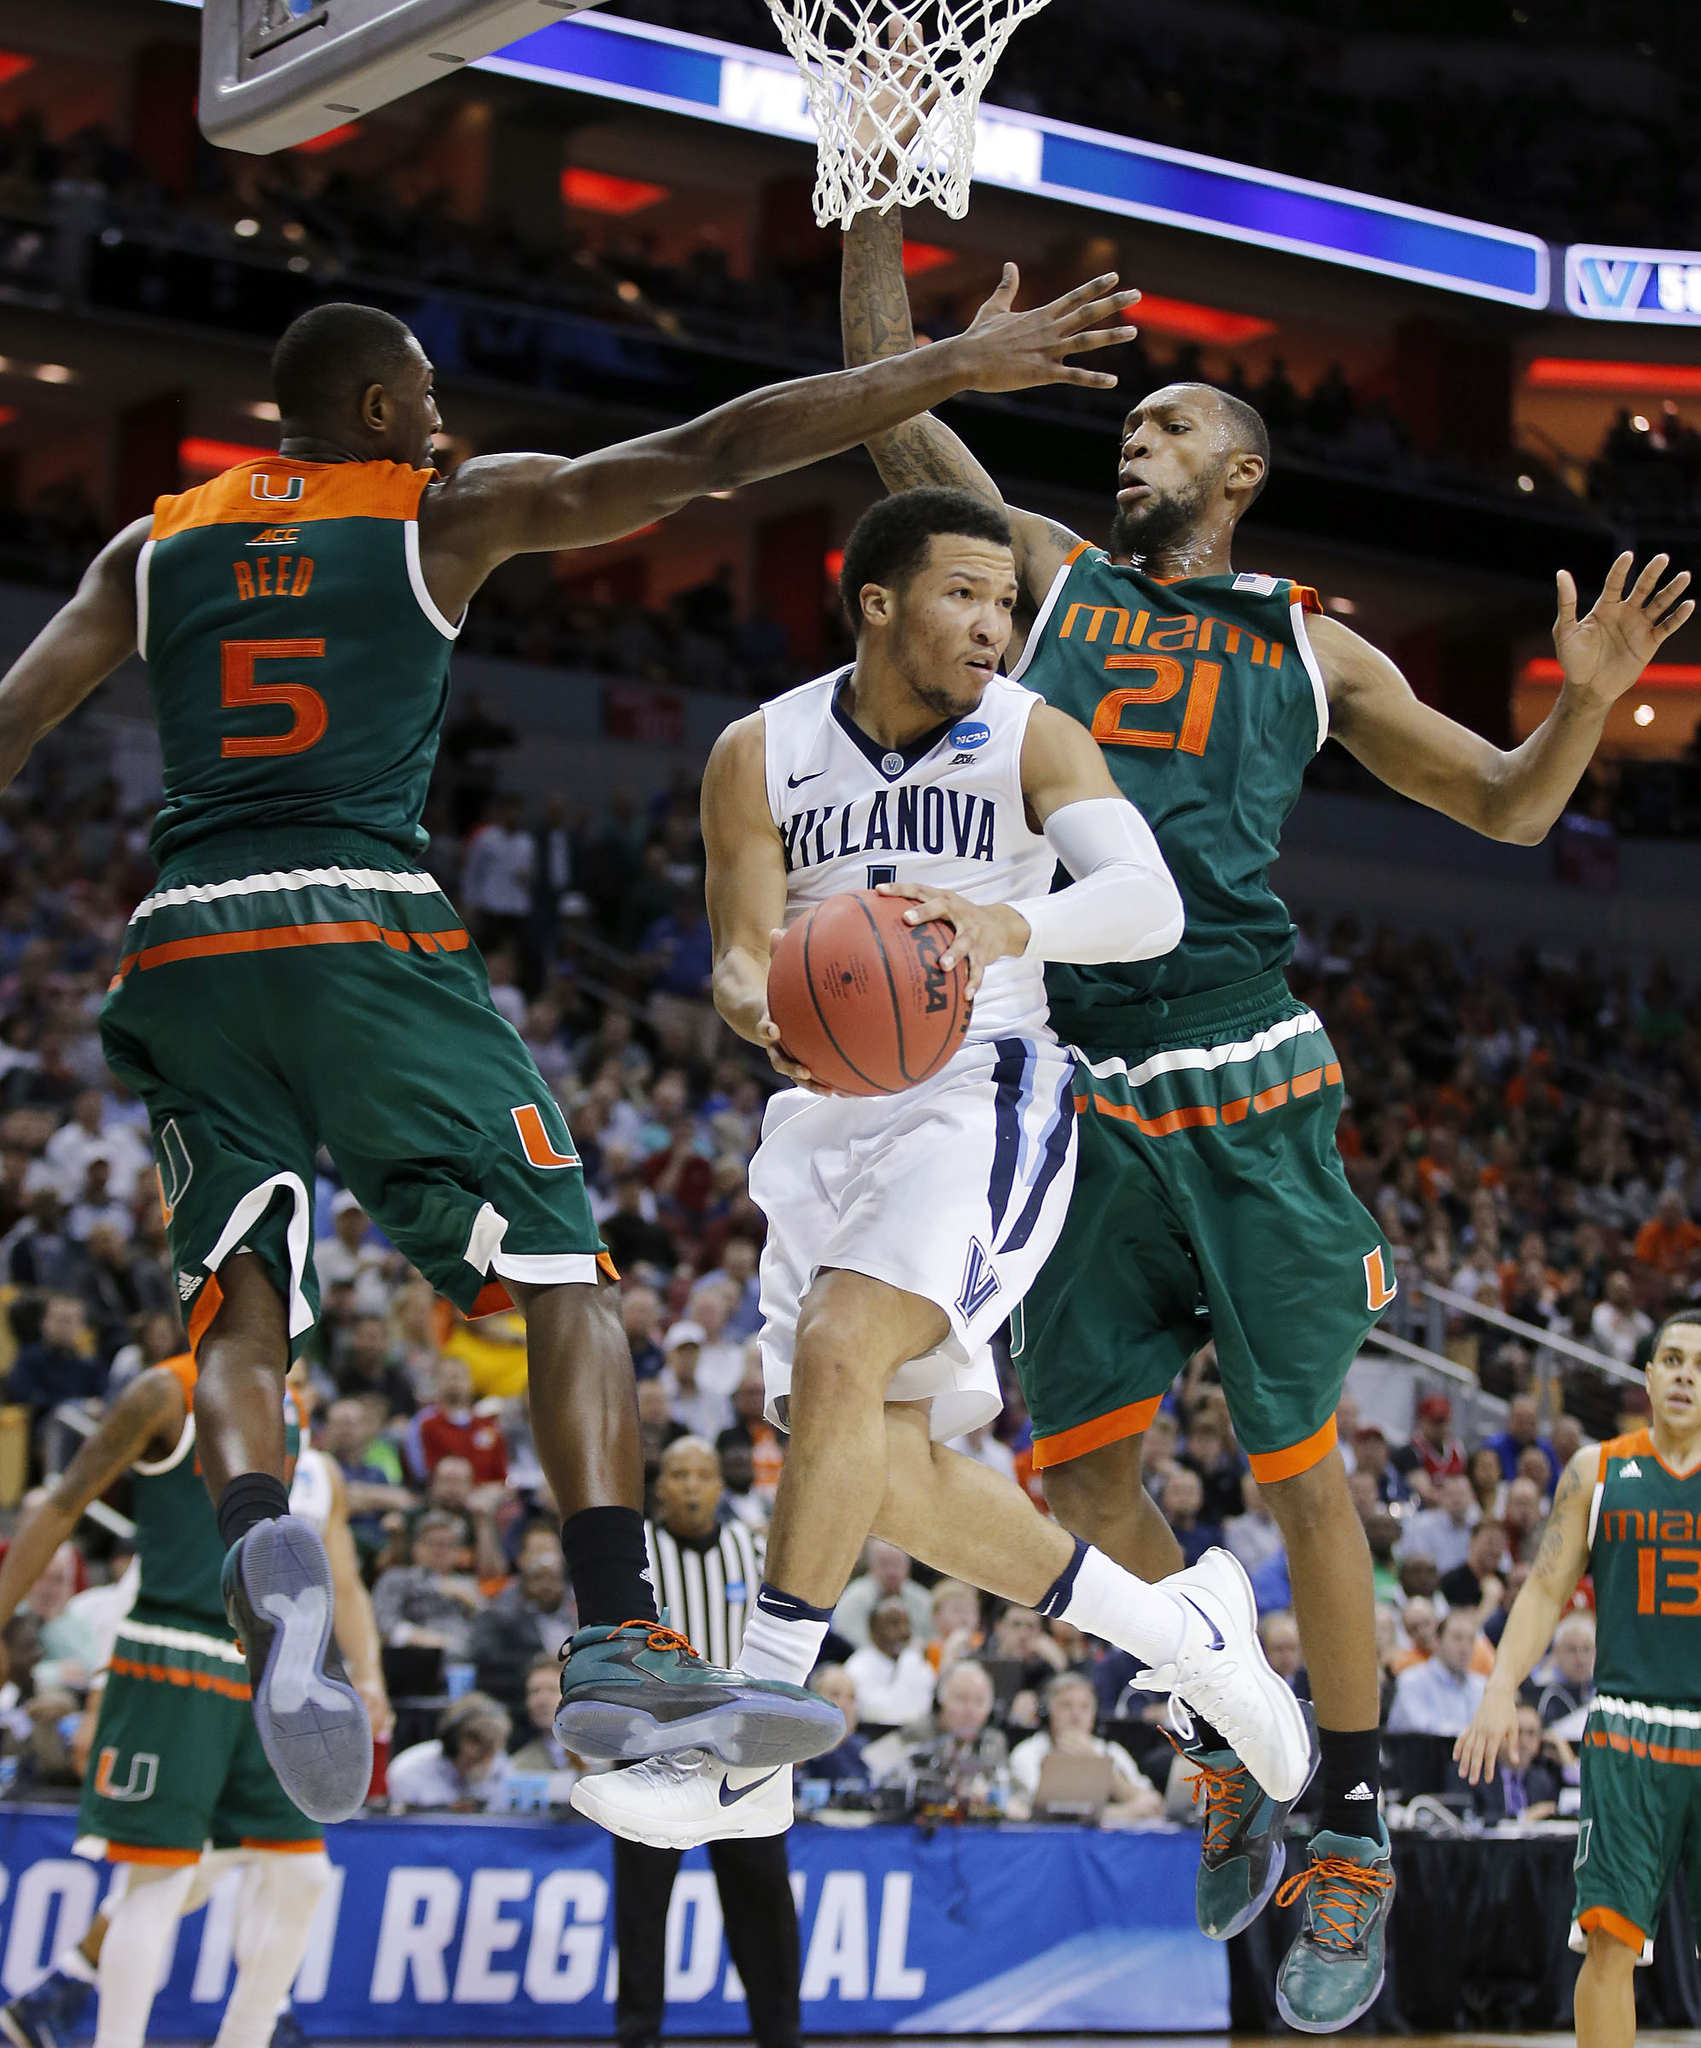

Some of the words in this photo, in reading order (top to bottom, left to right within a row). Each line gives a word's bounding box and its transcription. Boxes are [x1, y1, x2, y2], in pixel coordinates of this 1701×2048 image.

[251, 474, 305, 501] U
[251, 529, 301, 542] ACC
[232, 556, 315, 601] REED
[1059, 603, 1284, 670] MIAMI
[220, 638, 329, 758] 5
[1091, 654, 1223, 757] 21
[955, 731, 989, 745] NCAA
[780, 785, 996, 872] VILLANOVA
[181, 1275, 205, 1301] adidas
[954, 1235, 1001, 1328] V
[1603, 1509, 1701, 1542] MIA
[1637, 1547, 1701, 1616] 13
[95, 1746, 159, 1802] U
[369, 1866, 926, 2003] REGOAL
